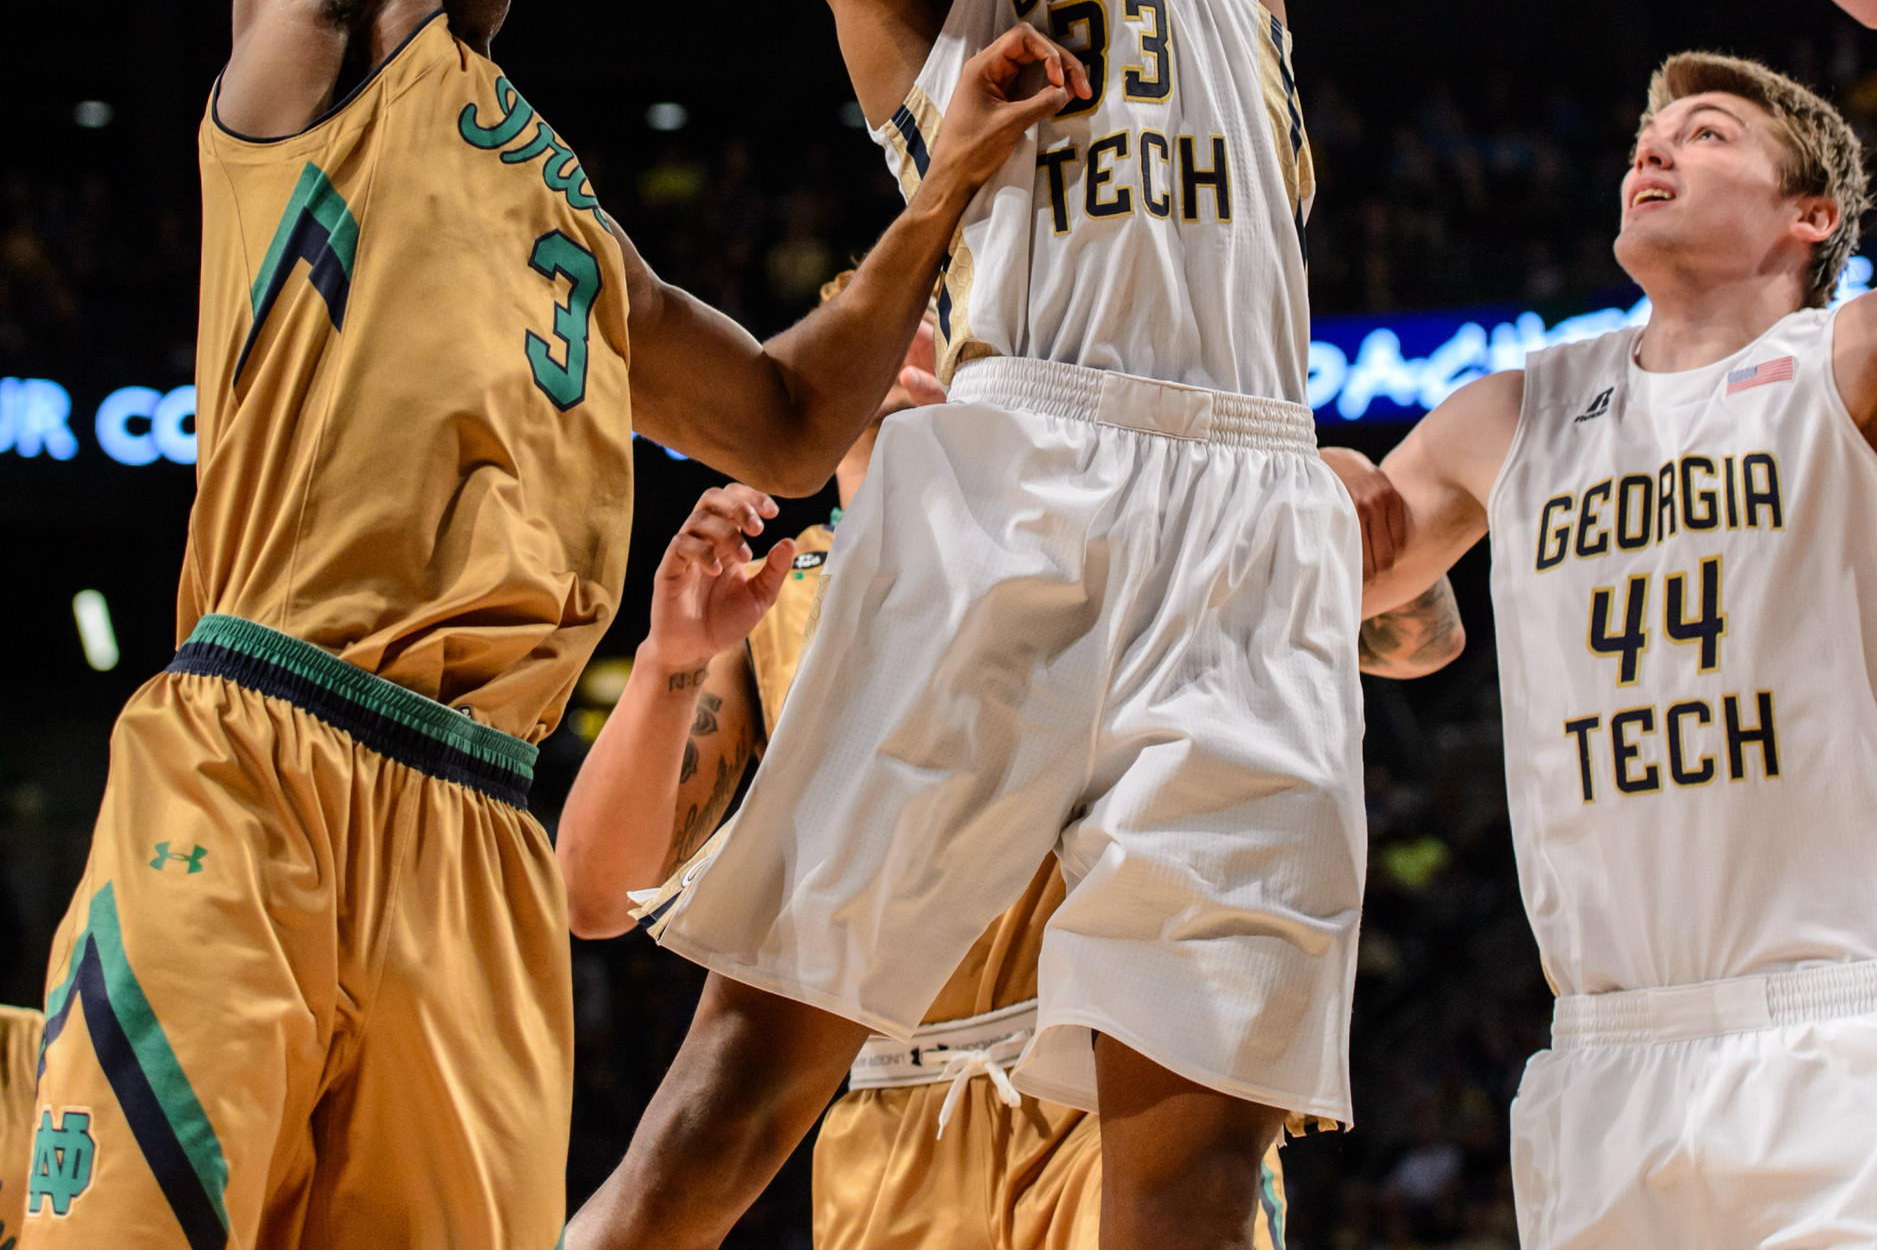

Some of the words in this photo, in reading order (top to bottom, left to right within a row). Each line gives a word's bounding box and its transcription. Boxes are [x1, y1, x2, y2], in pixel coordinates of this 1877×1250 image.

[1035, 127, 1233, 238] TECH
[524, 228, 604, 414] 3
[1535, 452, 1786, 575] GEORGIA
[1586, 553, 1729, 689] 44
[1563, 688, 1783, 806] TECH
